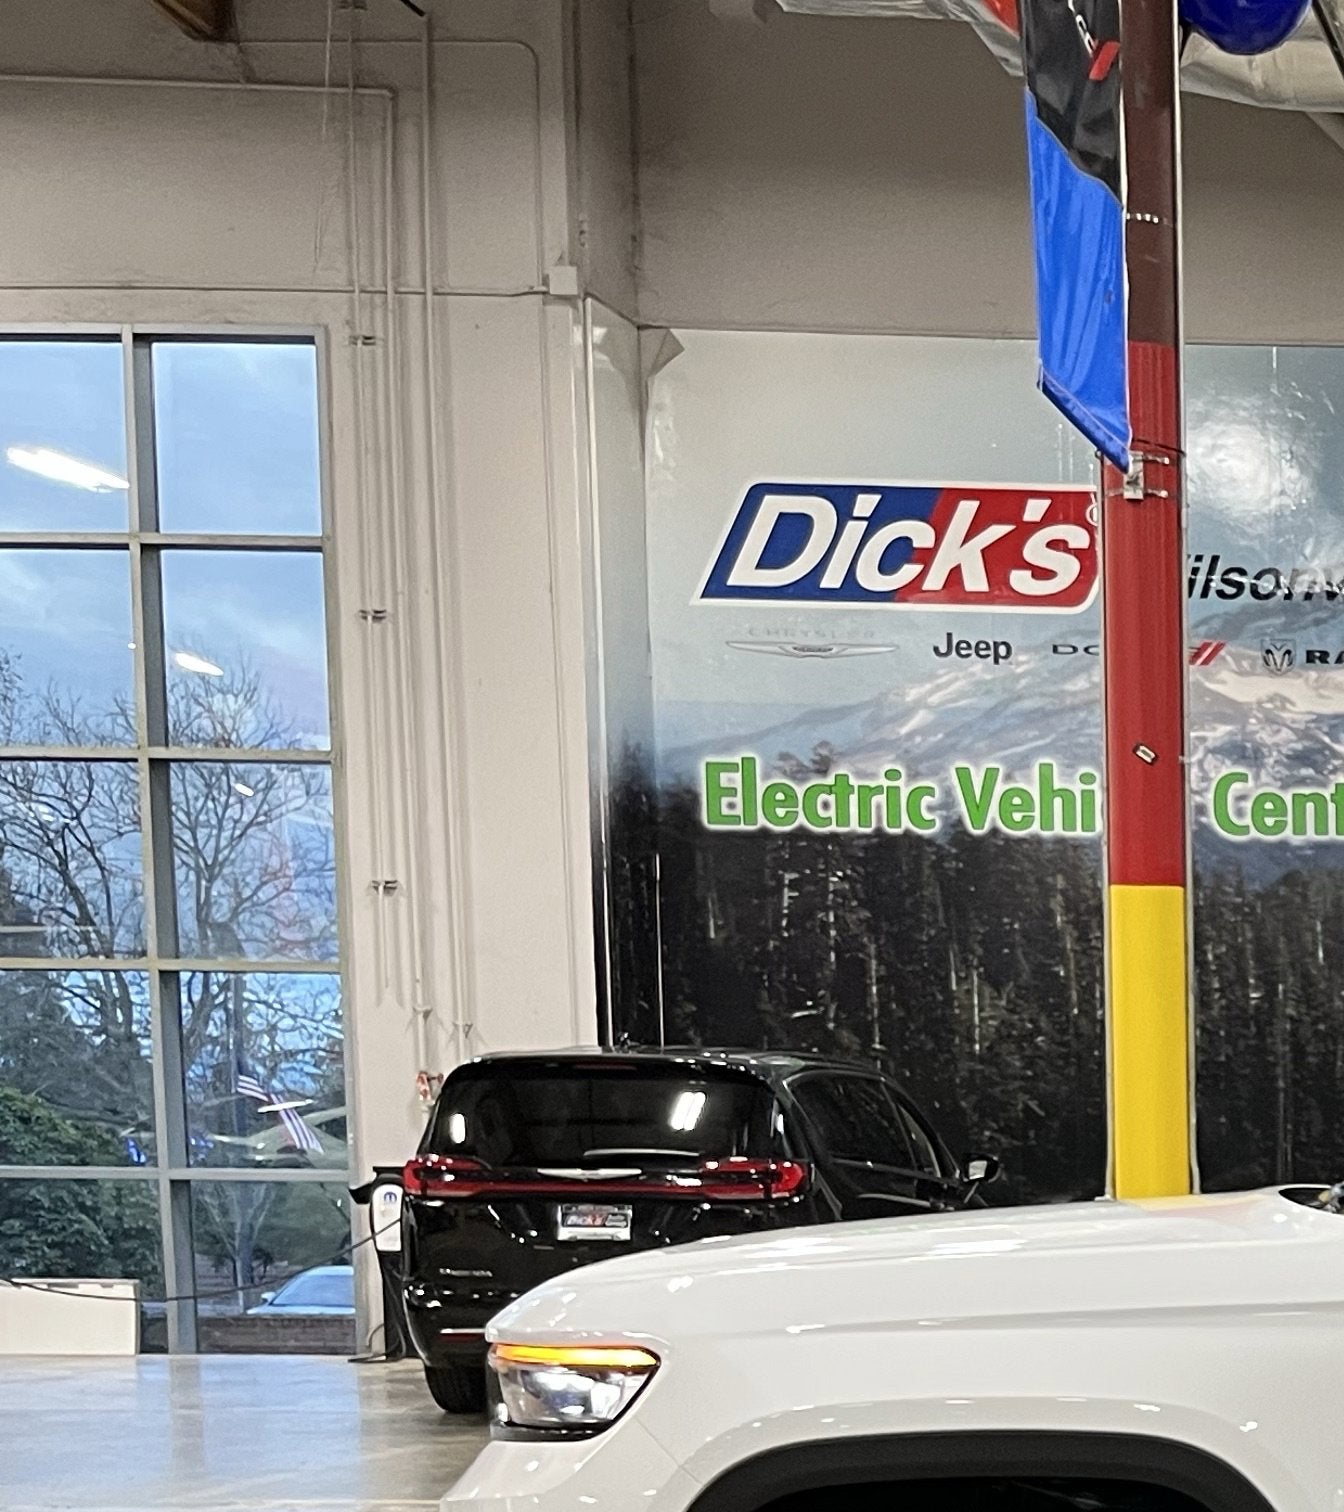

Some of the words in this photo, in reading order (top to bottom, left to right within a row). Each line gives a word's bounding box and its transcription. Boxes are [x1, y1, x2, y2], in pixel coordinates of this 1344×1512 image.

[727, 494, 1091, 597] Dick's
[933, 632, 1013, 666] Jeep
[706, 756, 937, 830] Electric
[955, 763, 1098, 833] Vehi
